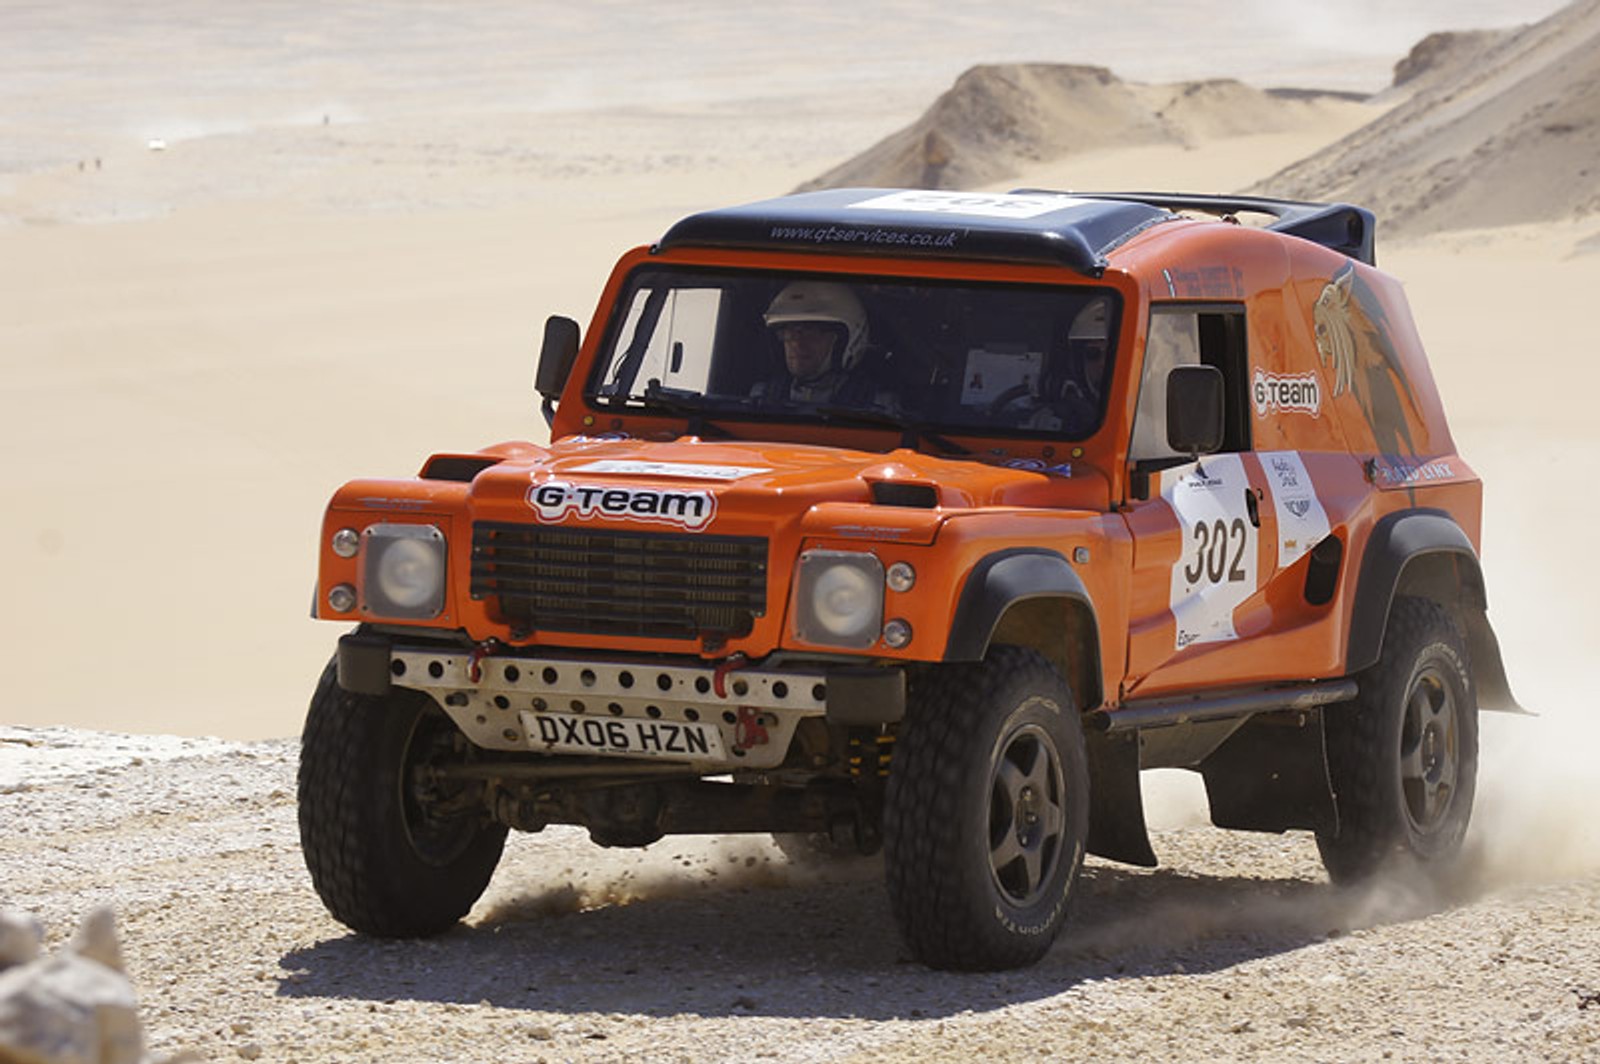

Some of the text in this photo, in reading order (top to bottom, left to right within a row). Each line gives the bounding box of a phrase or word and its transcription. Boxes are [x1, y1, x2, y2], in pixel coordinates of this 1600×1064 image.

[1184, 517, 1248, 585] 302
[536, 715, 710, 754] DX06 HZN
